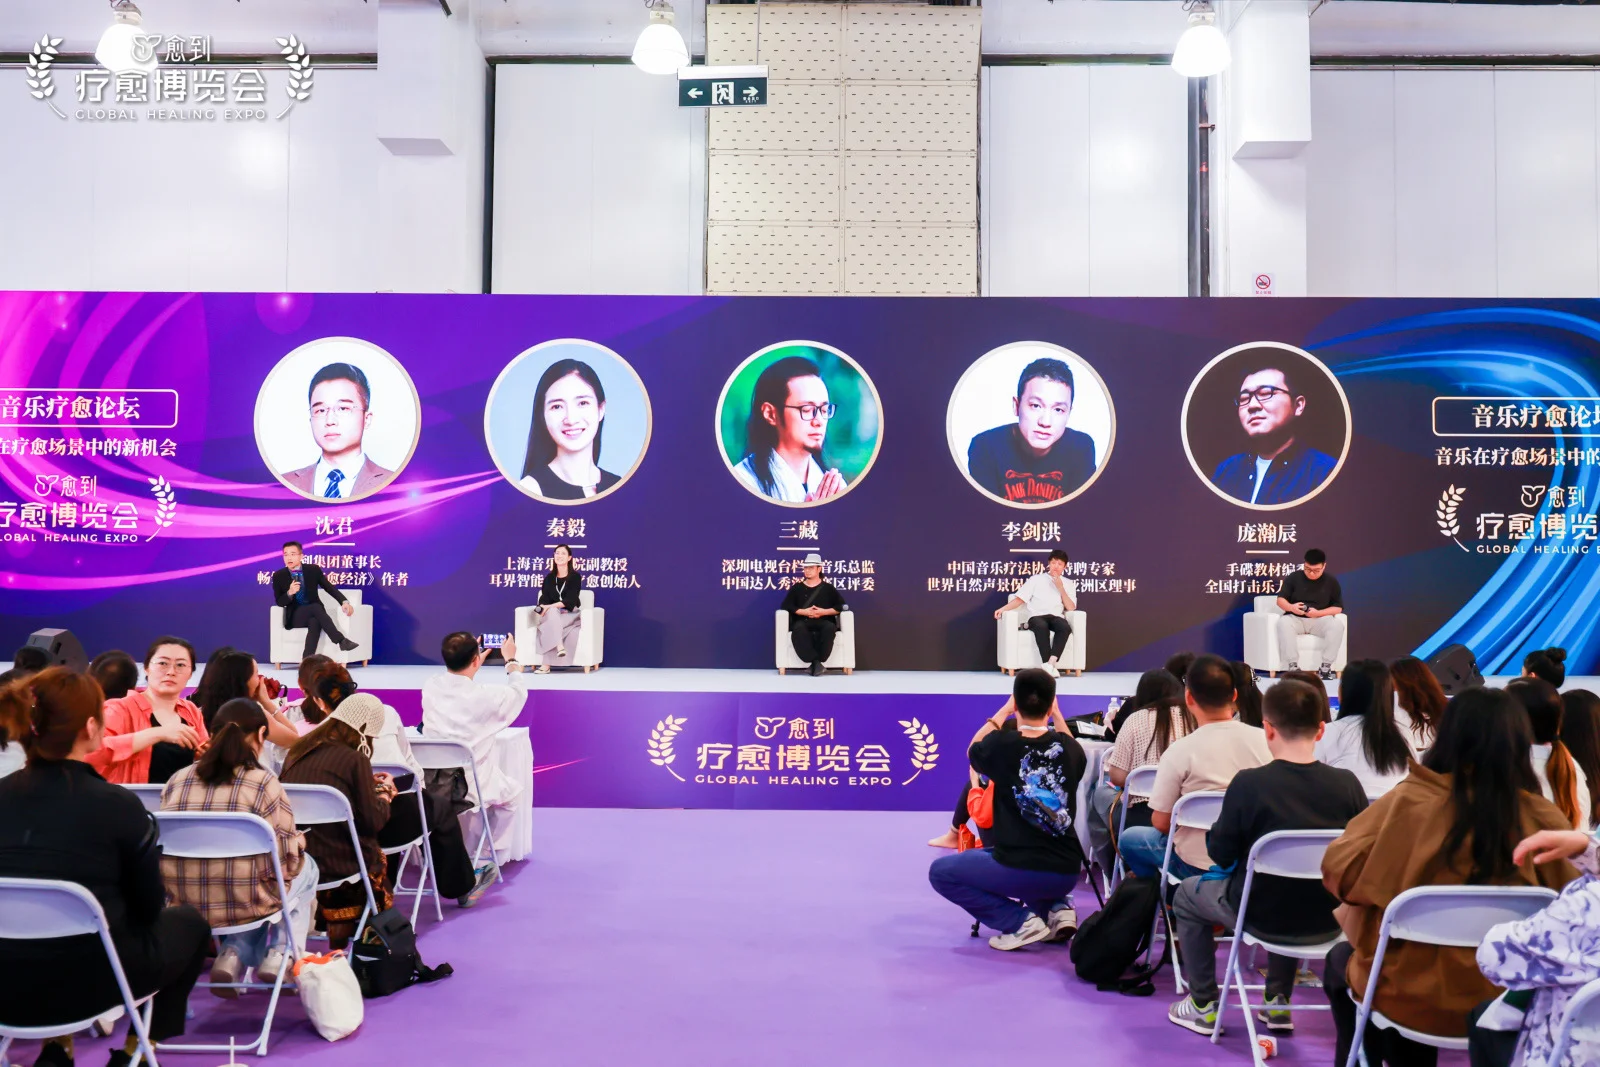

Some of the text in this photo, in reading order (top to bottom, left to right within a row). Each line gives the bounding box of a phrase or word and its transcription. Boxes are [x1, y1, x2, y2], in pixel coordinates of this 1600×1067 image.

[1, 396, 141, 419] 音乐疗愈论坛
[60, 475, 97, 497] 愈到
[1548, 485, 1585, 508] 愈到
[315, 515, 354, 536] 沈君
[546, 517, 586, 538] 秦毅
[779, 520, 819, 540] 三藏
[1001, 521, 1061, 542] 李剑洪
[1237, 523, 1298, 543] 庞瀚辰
[0, 533, 138, 543] OBAL HEALING EXPO
[1476, 544, 1526, 554] GLOBAL
[1534, 545, 1589, 554] HEALING
[503, 556, 628, 572] 上海音乐院副教授
[721, 558, 875, 574] 深圳电视台栏音乐总监
[489, 574, 641, 589] 耳界智能愈创始人
[721, 575, 875, 592] 中国达人秀区评委
[788, 718, 835, 740] 愈到
[697, 743, 891, 772] 疗愈博览会
[695, 774, 892, 786] GLOBAL HEALING EXPO
